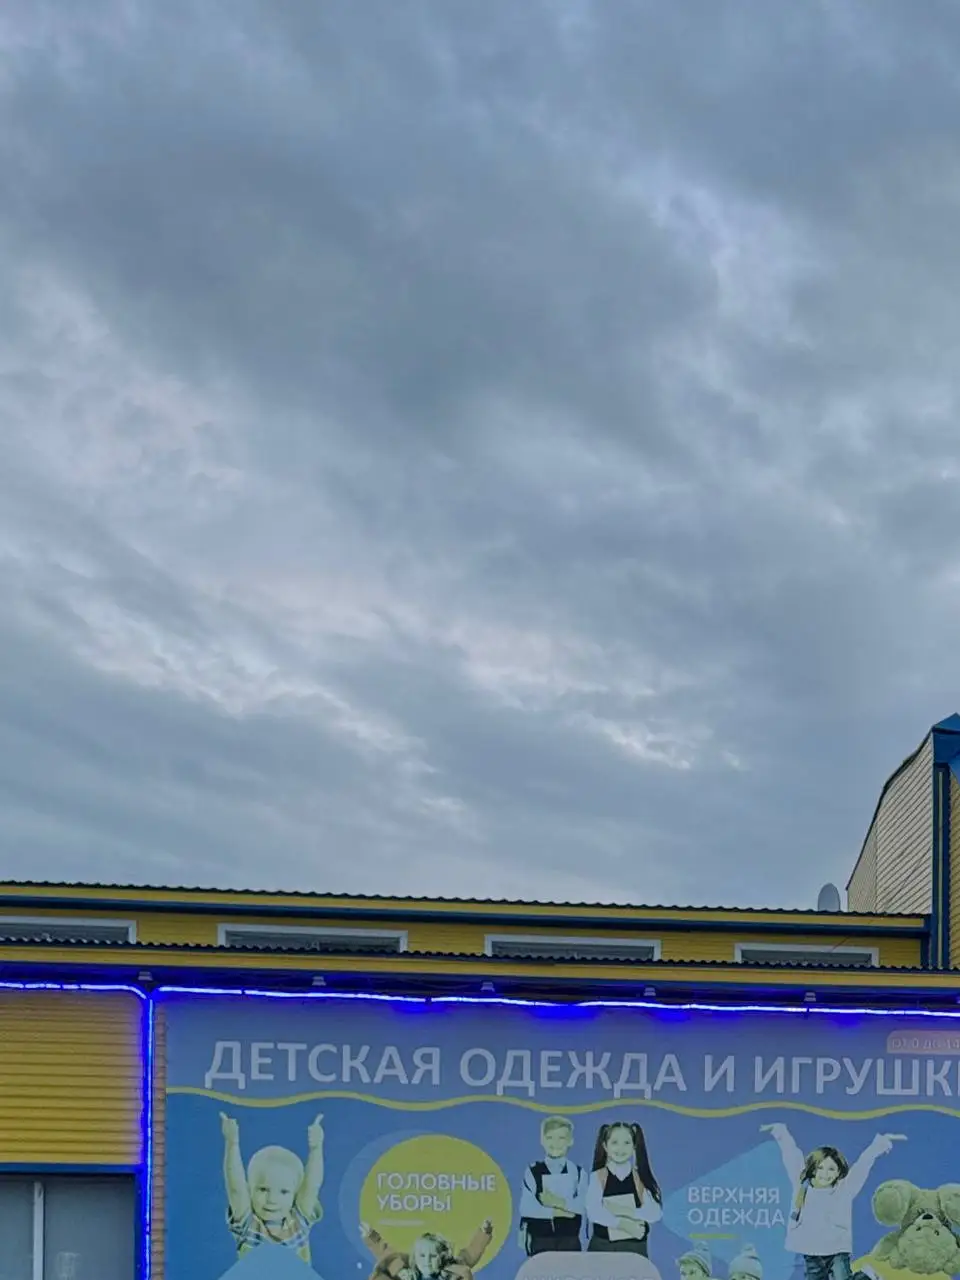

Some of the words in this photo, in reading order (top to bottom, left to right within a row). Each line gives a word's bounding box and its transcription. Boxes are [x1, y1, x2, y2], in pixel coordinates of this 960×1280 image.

[204, 1040, 441, 1090] ДЕТСКАЯ
[460, 1047, 687, 1100] ОДЕЖДА
[704, 1054, 736, 1093] И
[376, 1170, 497, 1194] ГОЛОВНЫЕ
[376, 1193, 452, 1213] УБОРЫ
[687, 1186, 780, 1205] ВЕРХНЯЯ
[687, 1207, 785, 1229] ОДЕЖДА
